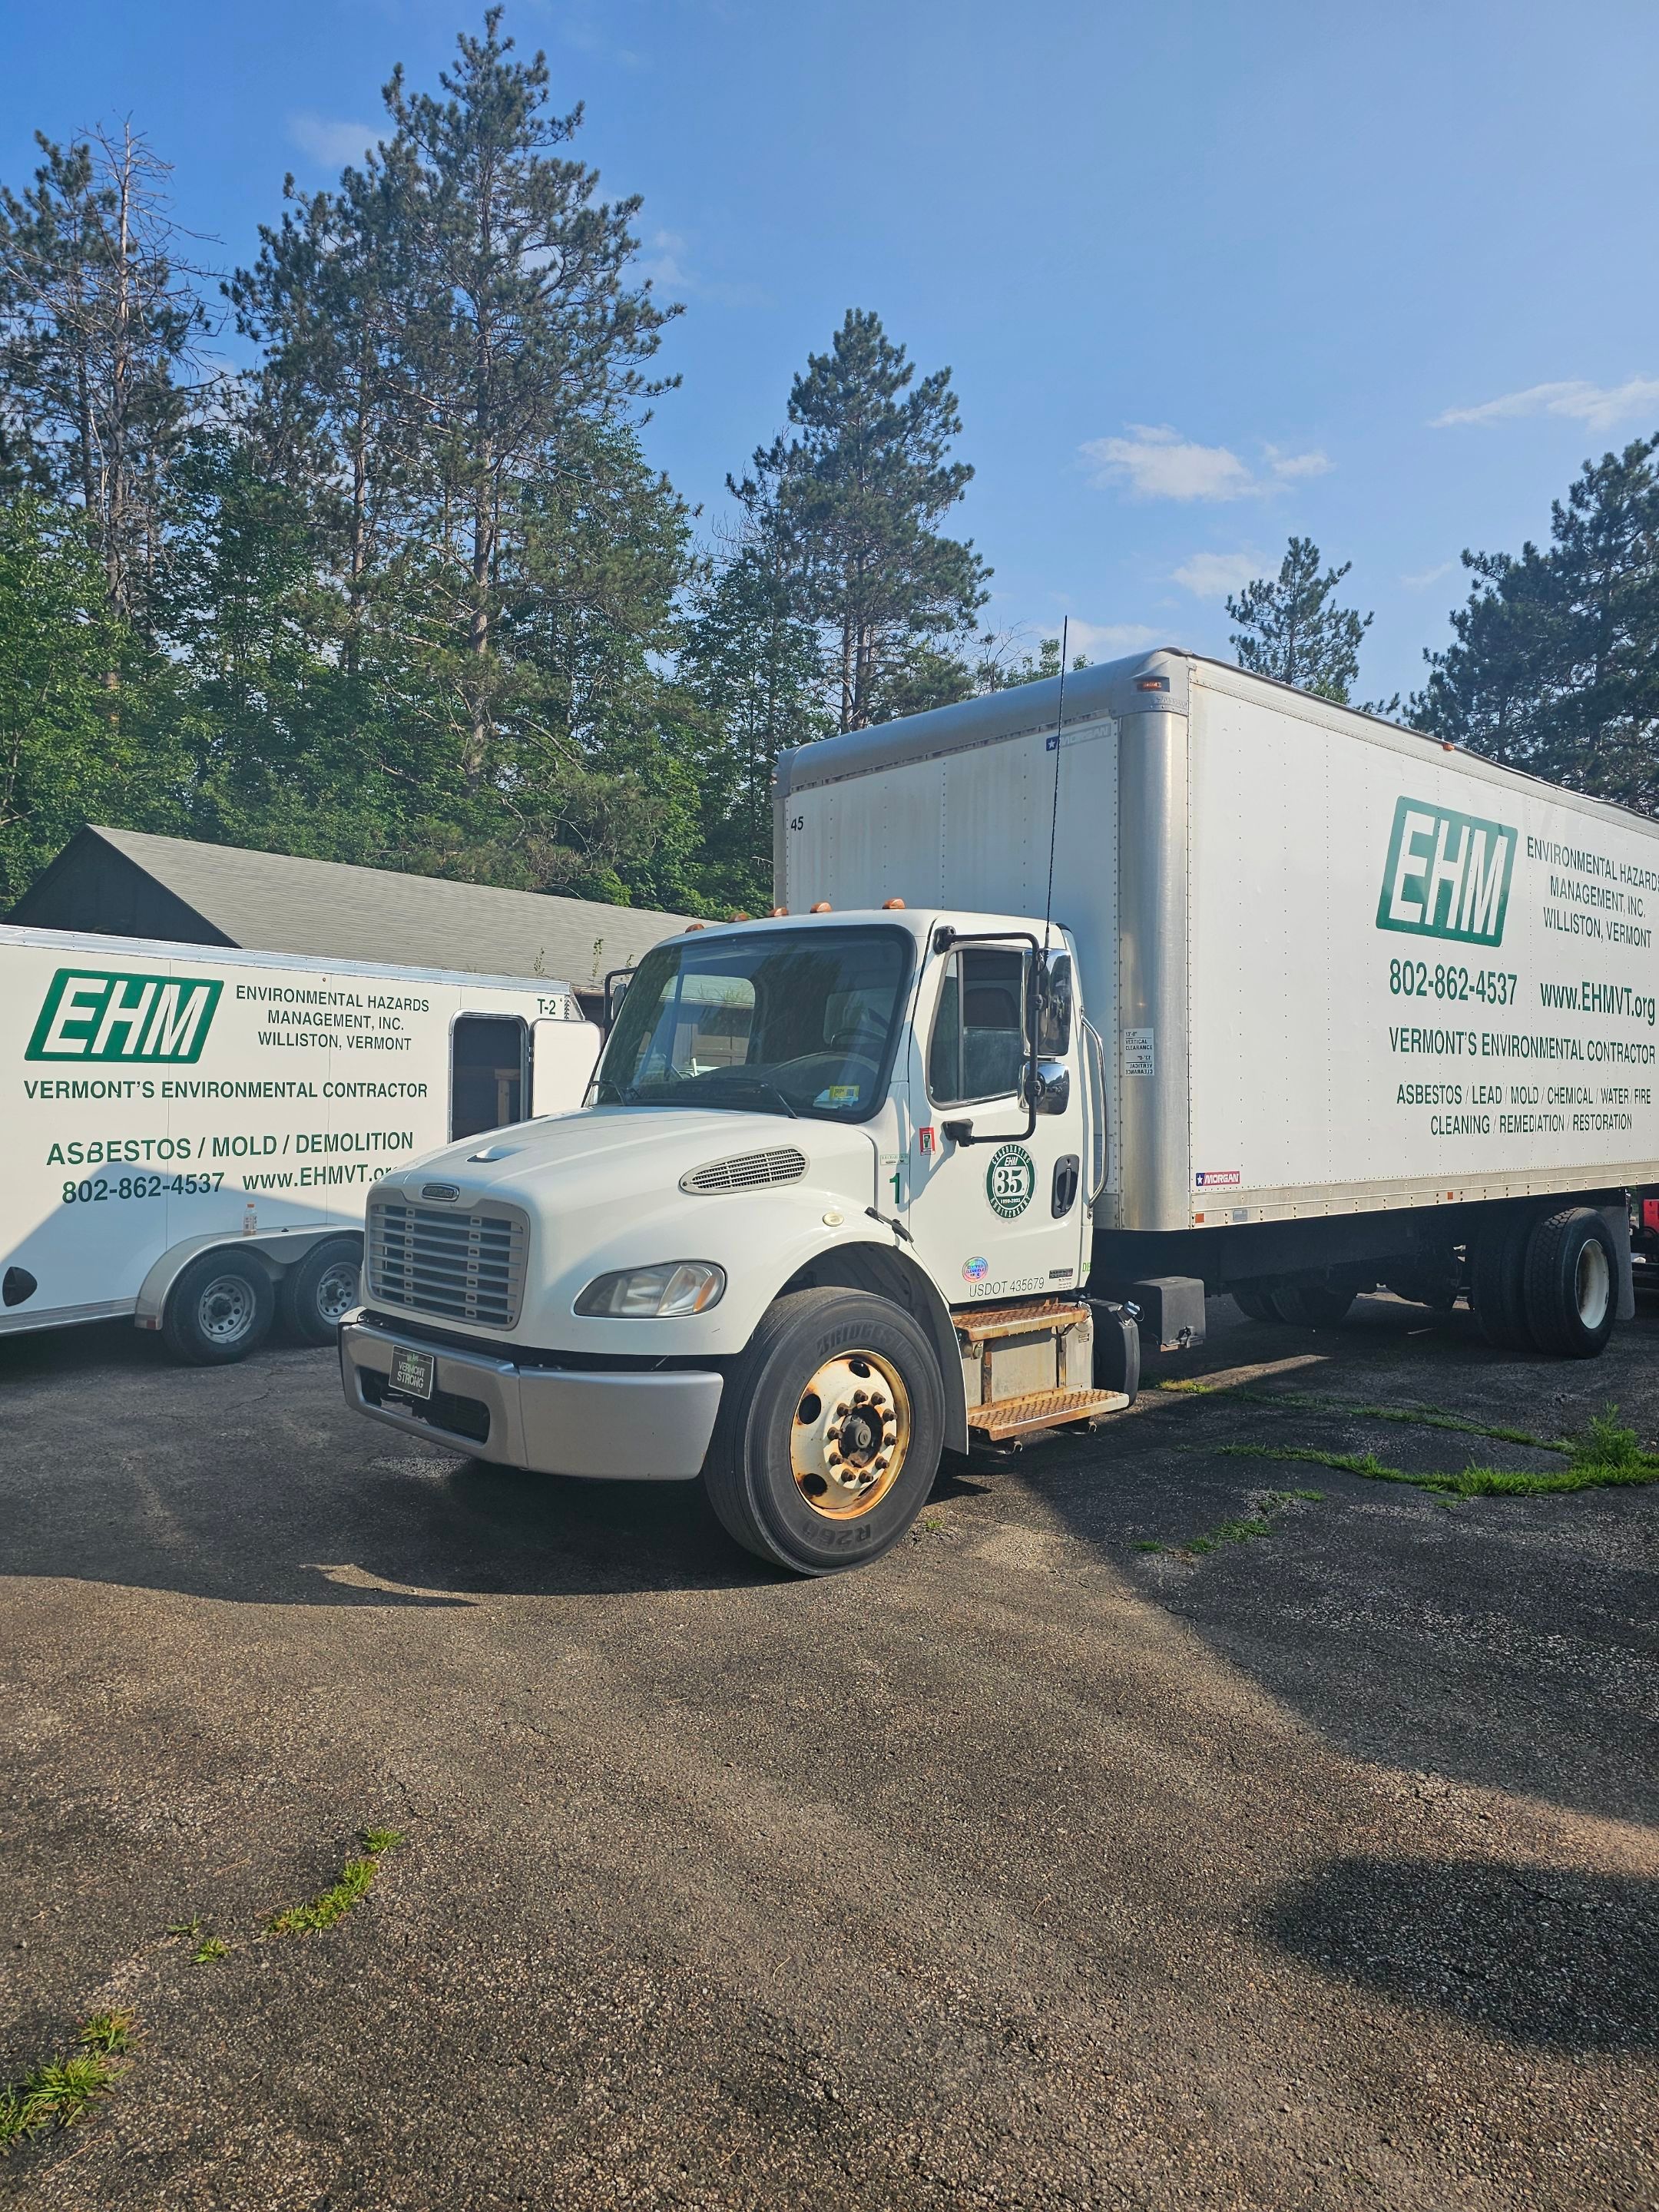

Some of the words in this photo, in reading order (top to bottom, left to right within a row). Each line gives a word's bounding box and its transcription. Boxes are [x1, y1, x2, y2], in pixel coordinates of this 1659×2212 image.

[790, 816, 804, 831] 45
[1527, 836, 1618, 881] ENVIRONMENTAL
[1389, 810, 1508, 935] EHM
[1550, 875, 1625, 917] MANAGEMENT,
[1628, 895, 1646, 918] INC.
[1543, 906, 1604, 943] WILLISTON,
[1606, 921, 1652, 949] VERMONT
[236, 985, 364, 1007] ENVIRONMENTAL
[367, 995, 430, 1012] HAZARDS
[1389, 958, 1518, 1005] 802-862-4537
[1540, 982, 1656, 1026] www.EHMVT.org
[41, 976, 211, 1056] EHM
[537, 998, 557, 1015] T-2
[267, 1009, 376, 1031] MANAGEMENT,
[378, 1016, 405, 1031] INC.
[258, 1031, 343, 1051] WILLISTON,
[346, 1036, 412, 1051] VERMONT
[1389, 1026, 1478, 1056] VERMONT'S
[1482, 1032, 1584, 1061] ENVIRONMENTAL
[1587, 1040, 1656, 1065] CONTRACTOR
[24, 1080, 155, 1099] VERMONT'S
[161, 1081, 318, 1098] ENVIRONMENTAL
[323, 1082, 428, 1098] CONTRACTOR
[1396, 1084, 1462, 1104] ASBESTOS
[1472, 1085, 1502, 1104] LEAD
[1511, 1086, 1538, 1104] MOLD
[1547, 1087, 1594, 1104] CHEMICAL
[1601, 1088, 1629, 1104] WATER
[1634, 1088, 1651, 1104] FIRE
[1430, 1115, 1490, 1135] CLEANING
[1499, 1114, 1565, 1133] REMEDIATION
[1573, 1114, 1632, 1131] RESTORATION
[46, 1138, 192, 1165] ASBESTOS
[212, 1135, 277, 1157] MOLD
[296, 1131, 414, 1154] DEMOLITION
[1004, 1156, 1018, 1166] EHM
[61, 1172, 225, 1204] 802-862-4537
[242, 1164, 398, 1190] www.EHMVT.or
[889, 1172, 900, 1204] 1
[997, 1169, 1022, 1194] 35
[1204, 1174, 1240, 1184] MORGAN
[969, 1280, 1008, 1297] USDOT
[1009, 1277, 1045, 1293] 435679
[396, 1371, 424, 1389] STRONG
[399, 1361, 426, 1377] VERMONT
